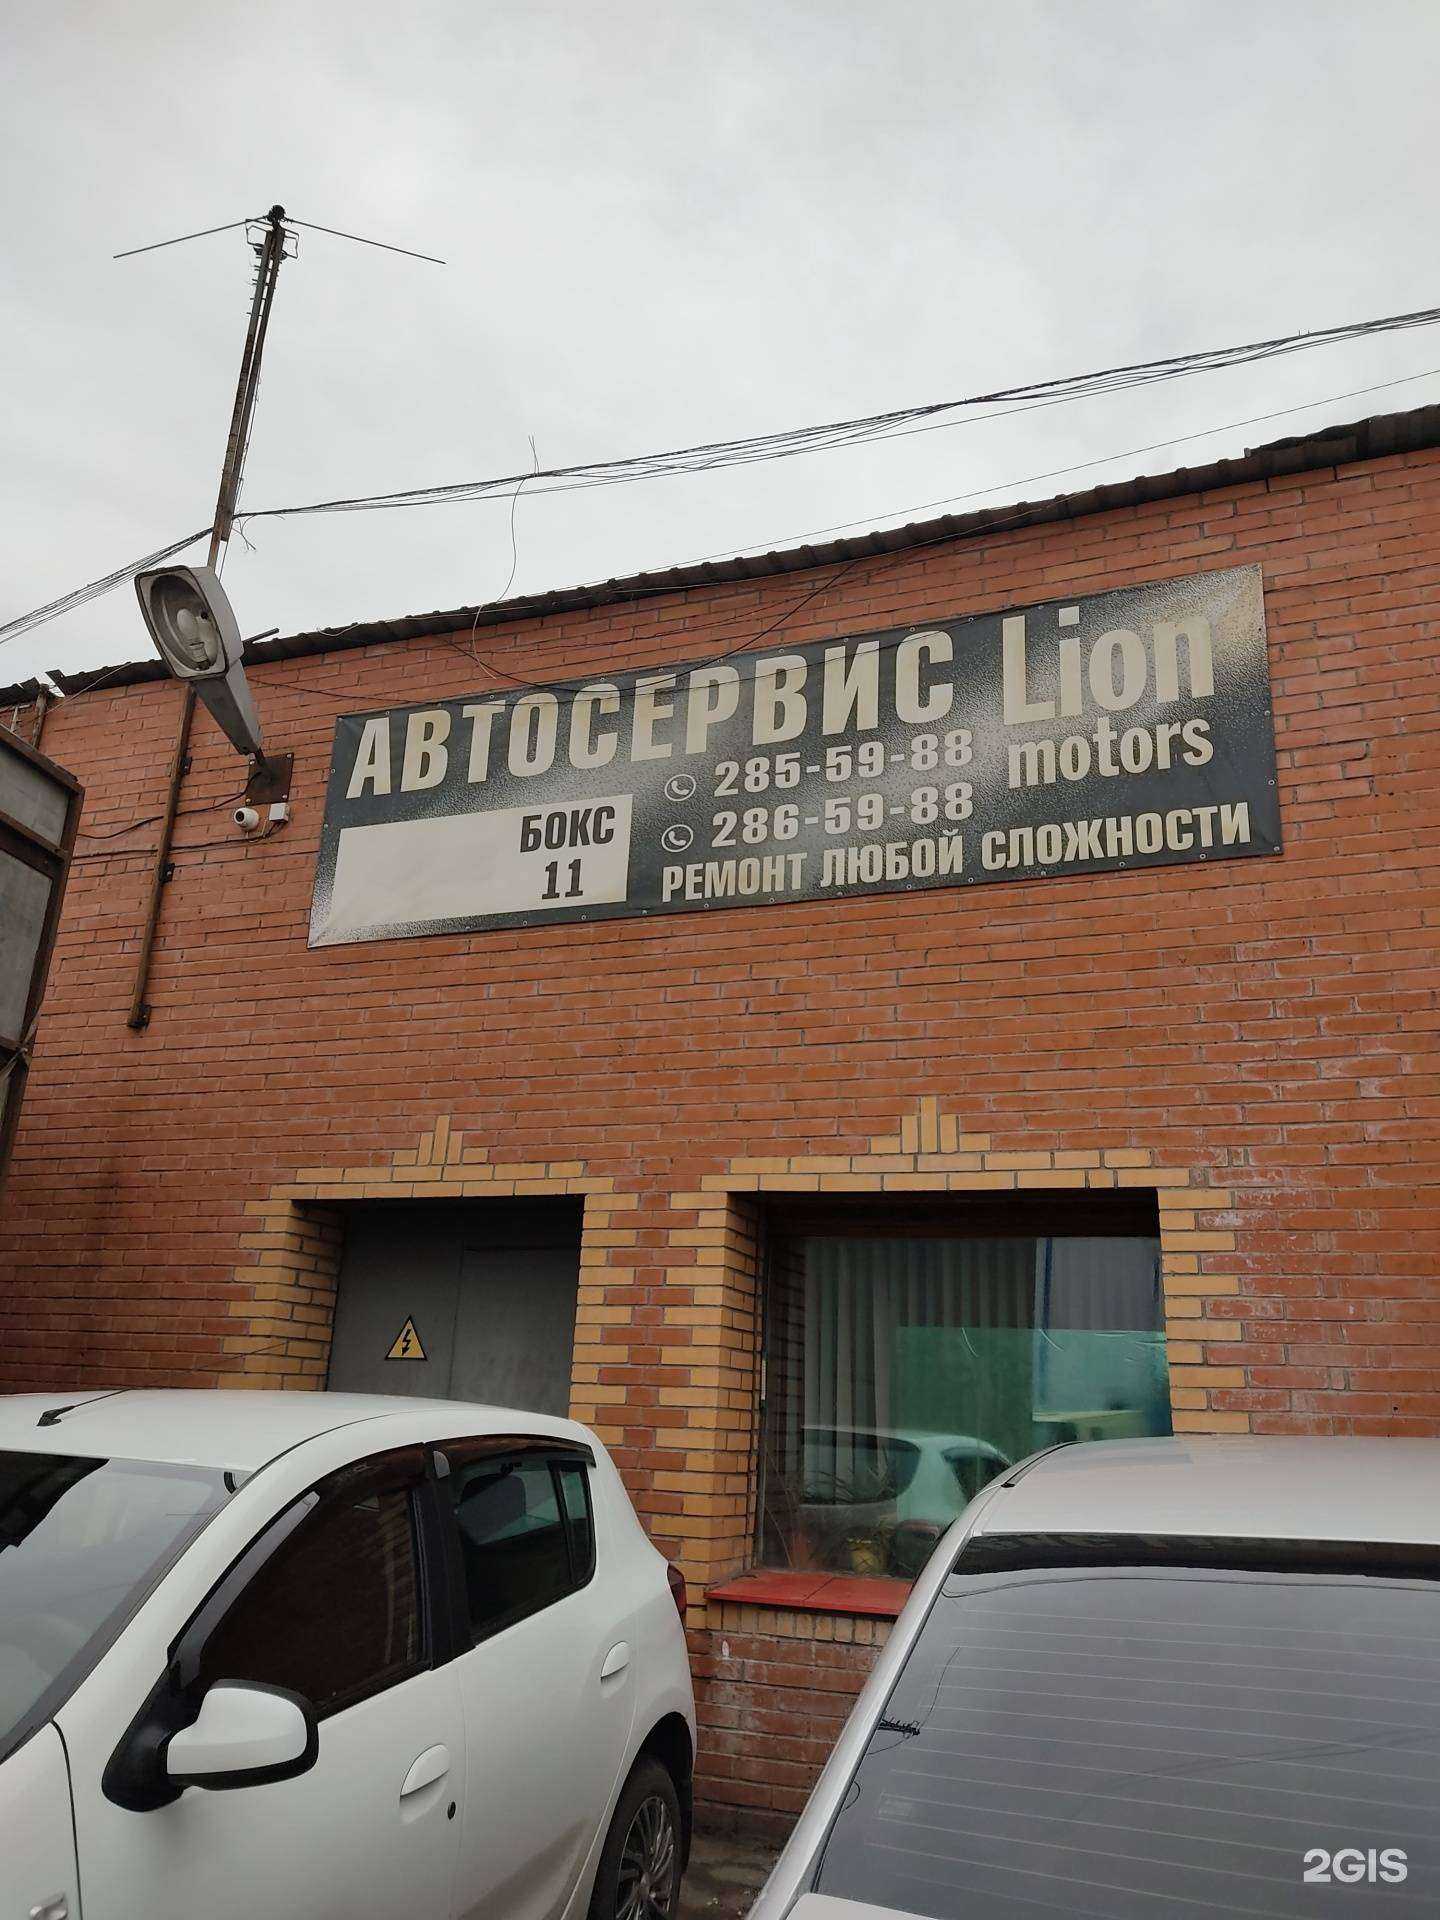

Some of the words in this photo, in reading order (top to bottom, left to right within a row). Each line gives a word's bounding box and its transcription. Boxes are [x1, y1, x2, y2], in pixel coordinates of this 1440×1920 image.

[1002, 606, 1215, 726] Lion
[345, 630, 954, 799] АВТОСЕРВИС
[713, 729, 973, 797] 285-59-88
[1008, 717, 1214, 789] motors
[520, 806, 616, 852] БОКС
[711, 782, 973, 847] 286-59-88
[541, 858, 584, 900] 11
[662, 852, 807, 902] РЕМОНТ
[820, 829, 963, 887] ЛЮБОЙ
[981, 801, 1252, 871] СЛОЖНОСТИ
